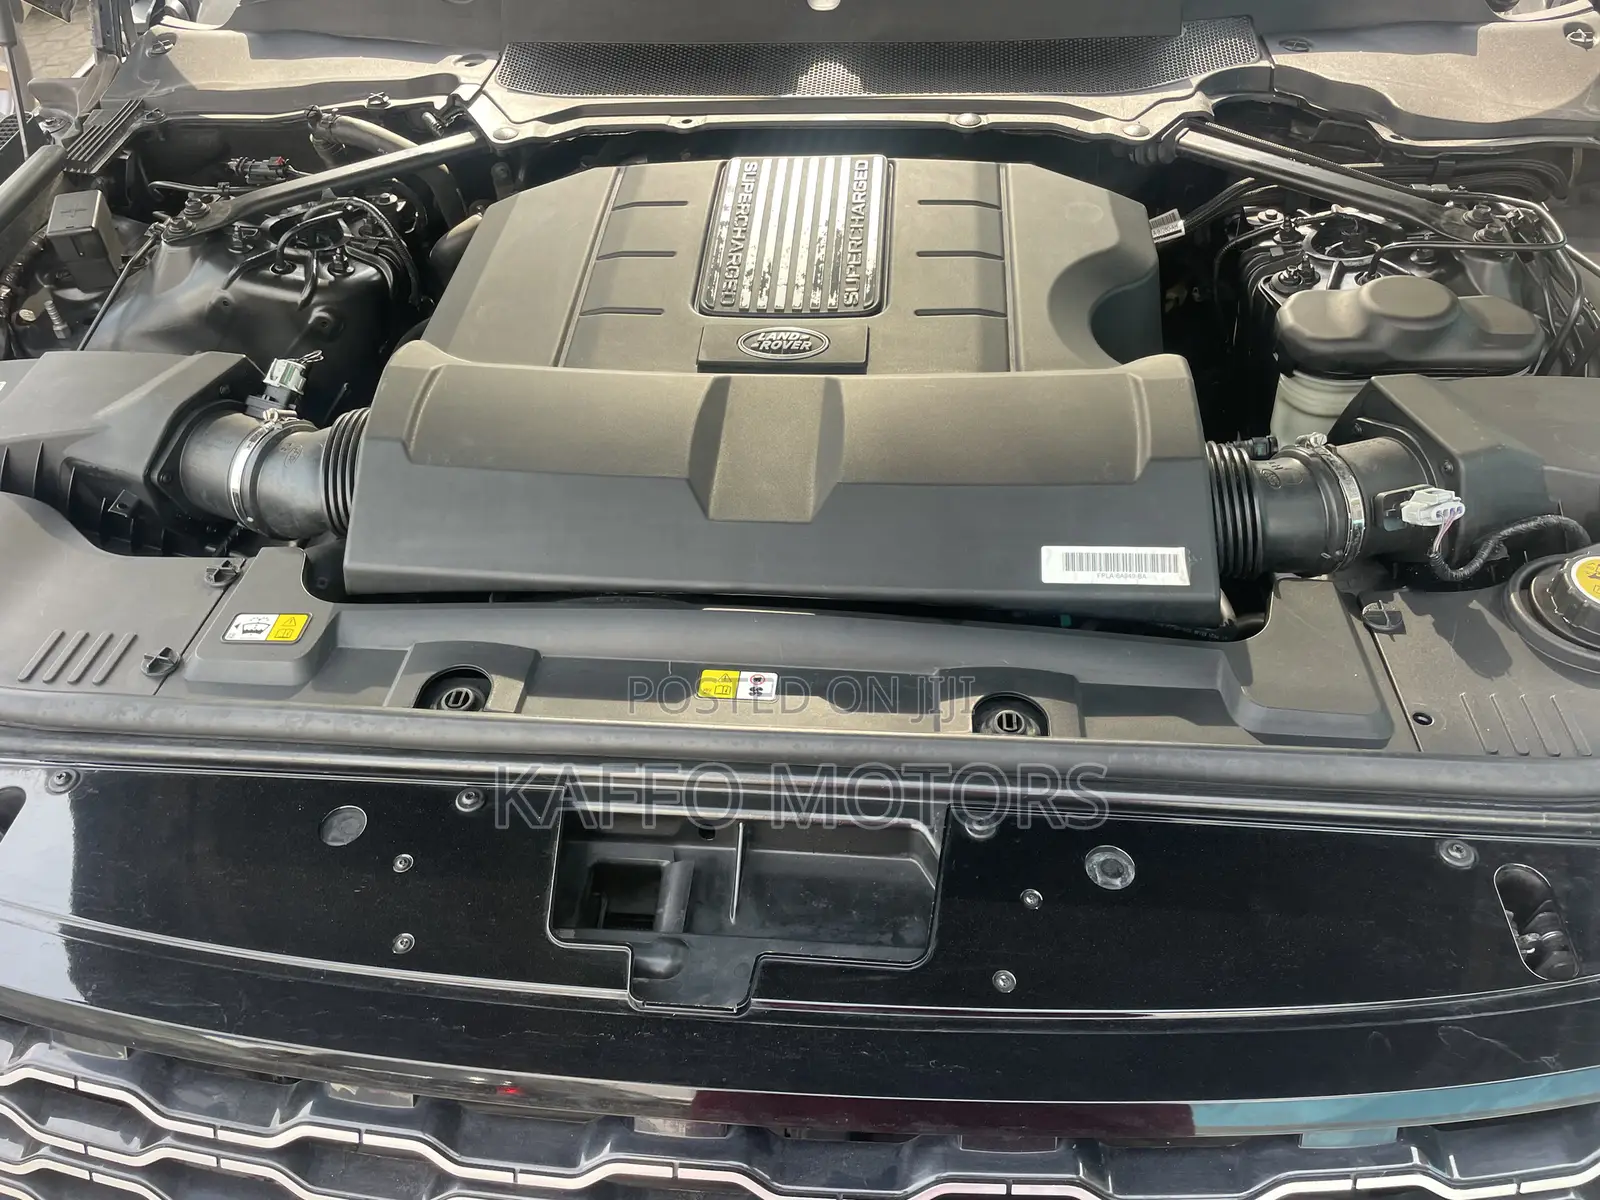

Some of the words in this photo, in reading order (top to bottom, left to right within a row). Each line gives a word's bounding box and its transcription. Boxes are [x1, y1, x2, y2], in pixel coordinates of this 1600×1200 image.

[720, 161, 758, 307] SUPERCHARGED
[843, 159, 869, 307] SUPERCHARGED
[757, 332, 800, 341] LAND
[758, 340, 813, 351] ROVER
